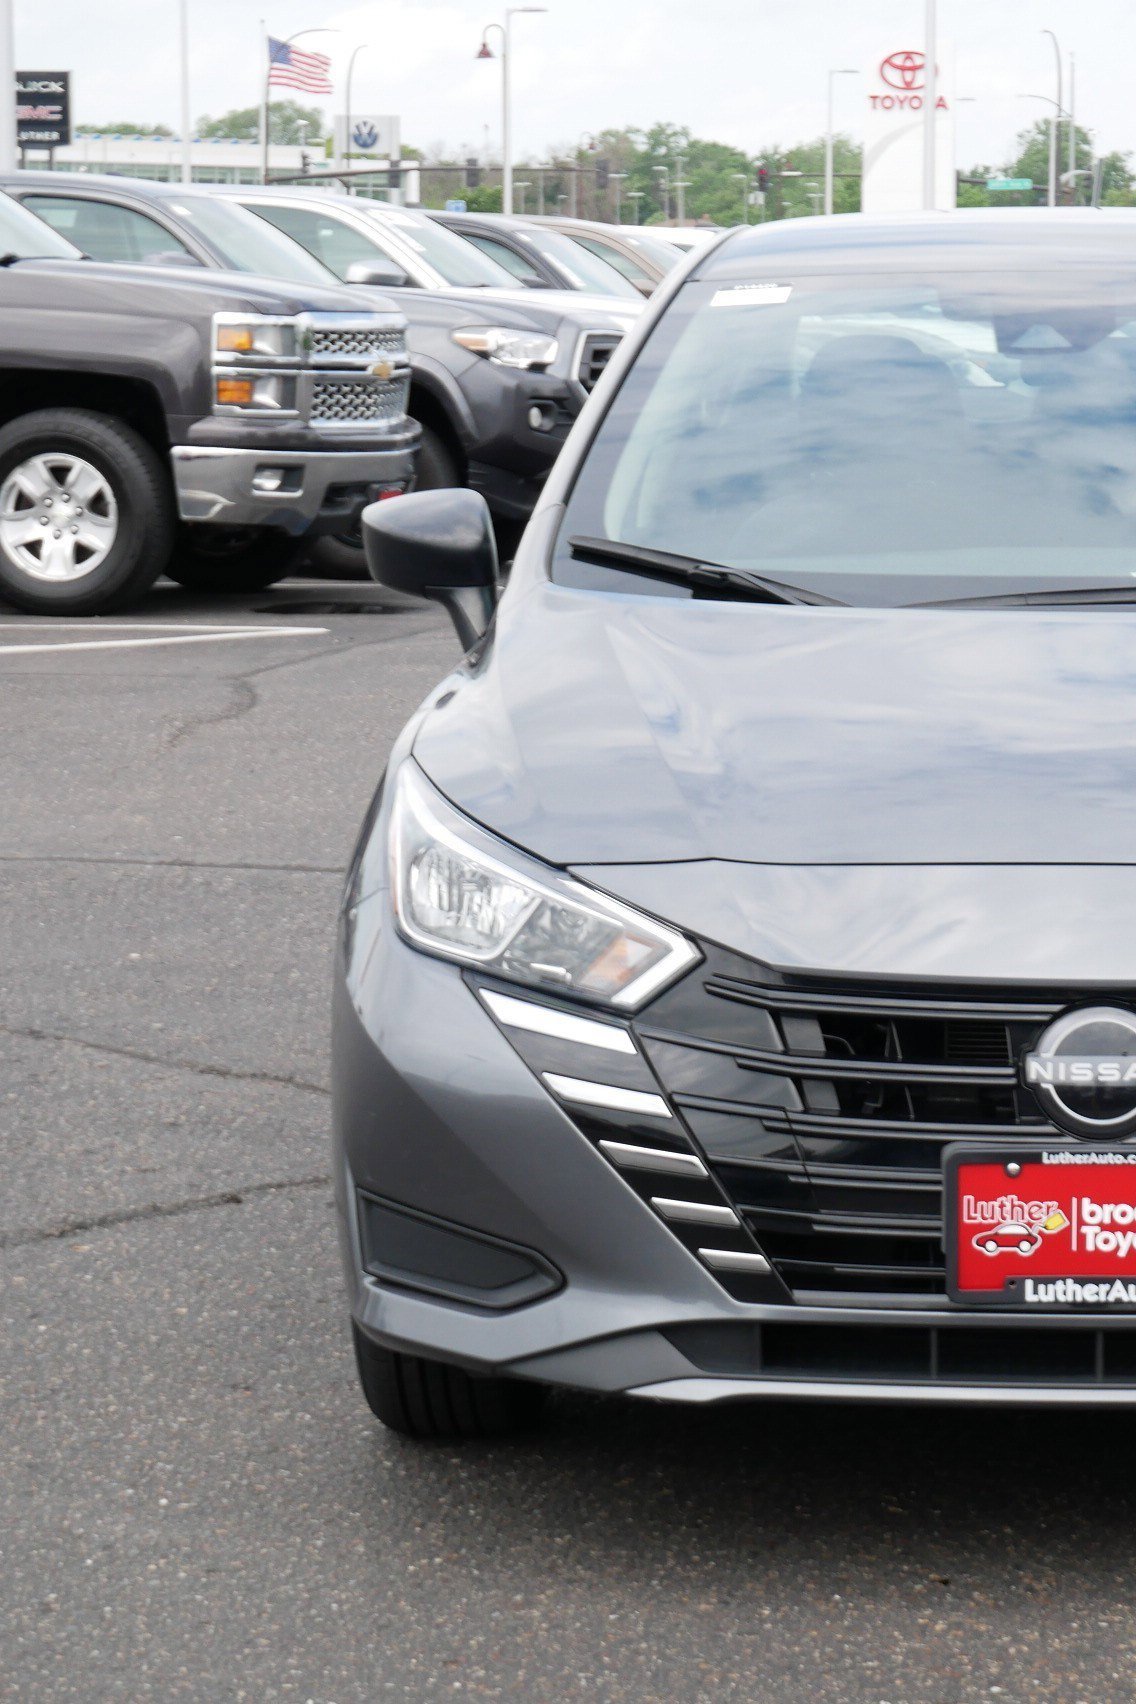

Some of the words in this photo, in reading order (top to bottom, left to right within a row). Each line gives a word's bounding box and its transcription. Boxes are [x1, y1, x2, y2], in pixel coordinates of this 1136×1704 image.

[15, 80, 66, 93] UICK
[869, 95, 949, 110] TOYOA
[962, 1194, 1059, 1224] Luther
